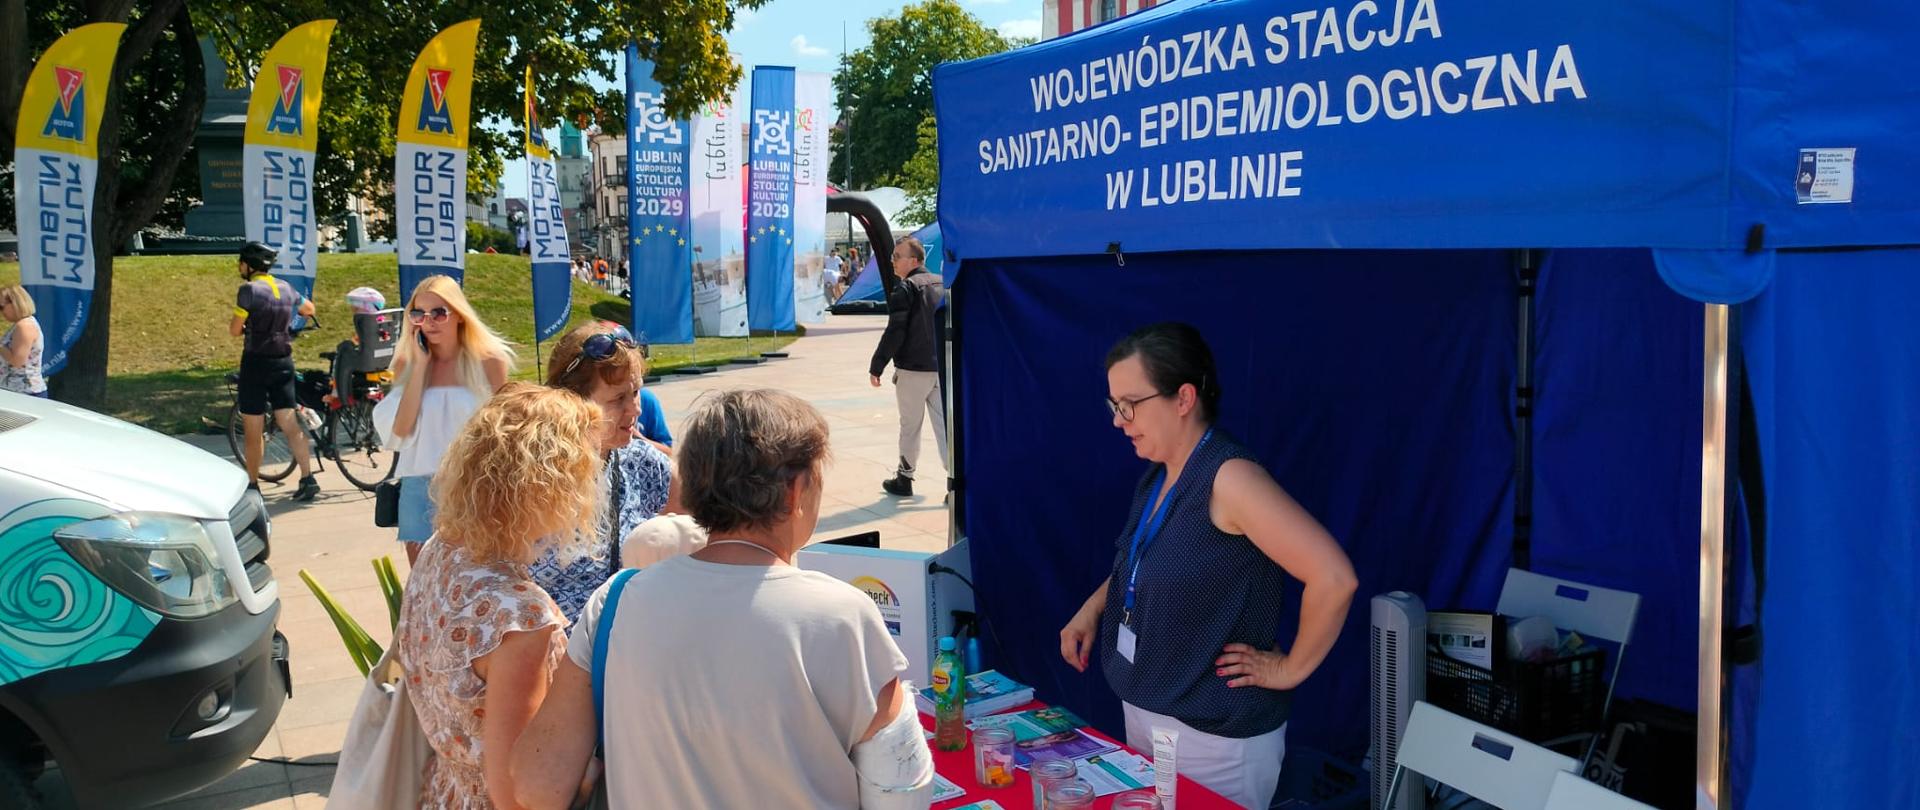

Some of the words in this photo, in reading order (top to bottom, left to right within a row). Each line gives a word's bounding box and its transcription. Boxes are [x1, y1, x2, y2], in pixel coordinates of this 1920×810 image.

[1031, 23, 1255, 112] WOJEWÓDZKA
[1265, 0, 1442, 64] STACJA
[979, 115, 1132, 174] SANITARNO-
[1140, 44, 1587, 148] EPIDEMIOLOGICZNA
[635, 150, 683, 164] LUBLIN
[635, 164, 683, 174] EUROPEJSKA
[753, 160, 791, 172] LUBLIN
[635, 174, 683, 186] STOLICA
[752, 180, 790, 192] STOLICA
[1106, 169, 1133, 210] W
[1141, 150, 1303, 207] LUBLINIE
[636, 186, 683, 197] KULTURY
[752, 191, 790, 202] KULTURY
[414, 152, 436, 260] MOTOR
[438, 152, 457, 262] LUBLIN
[531, 162, 554, 258] MOTOR
[543, 162, 569, 258] LUBLIN
[636, 198, 684, 216] 2029
[752, 202, 790, 218] 2029
